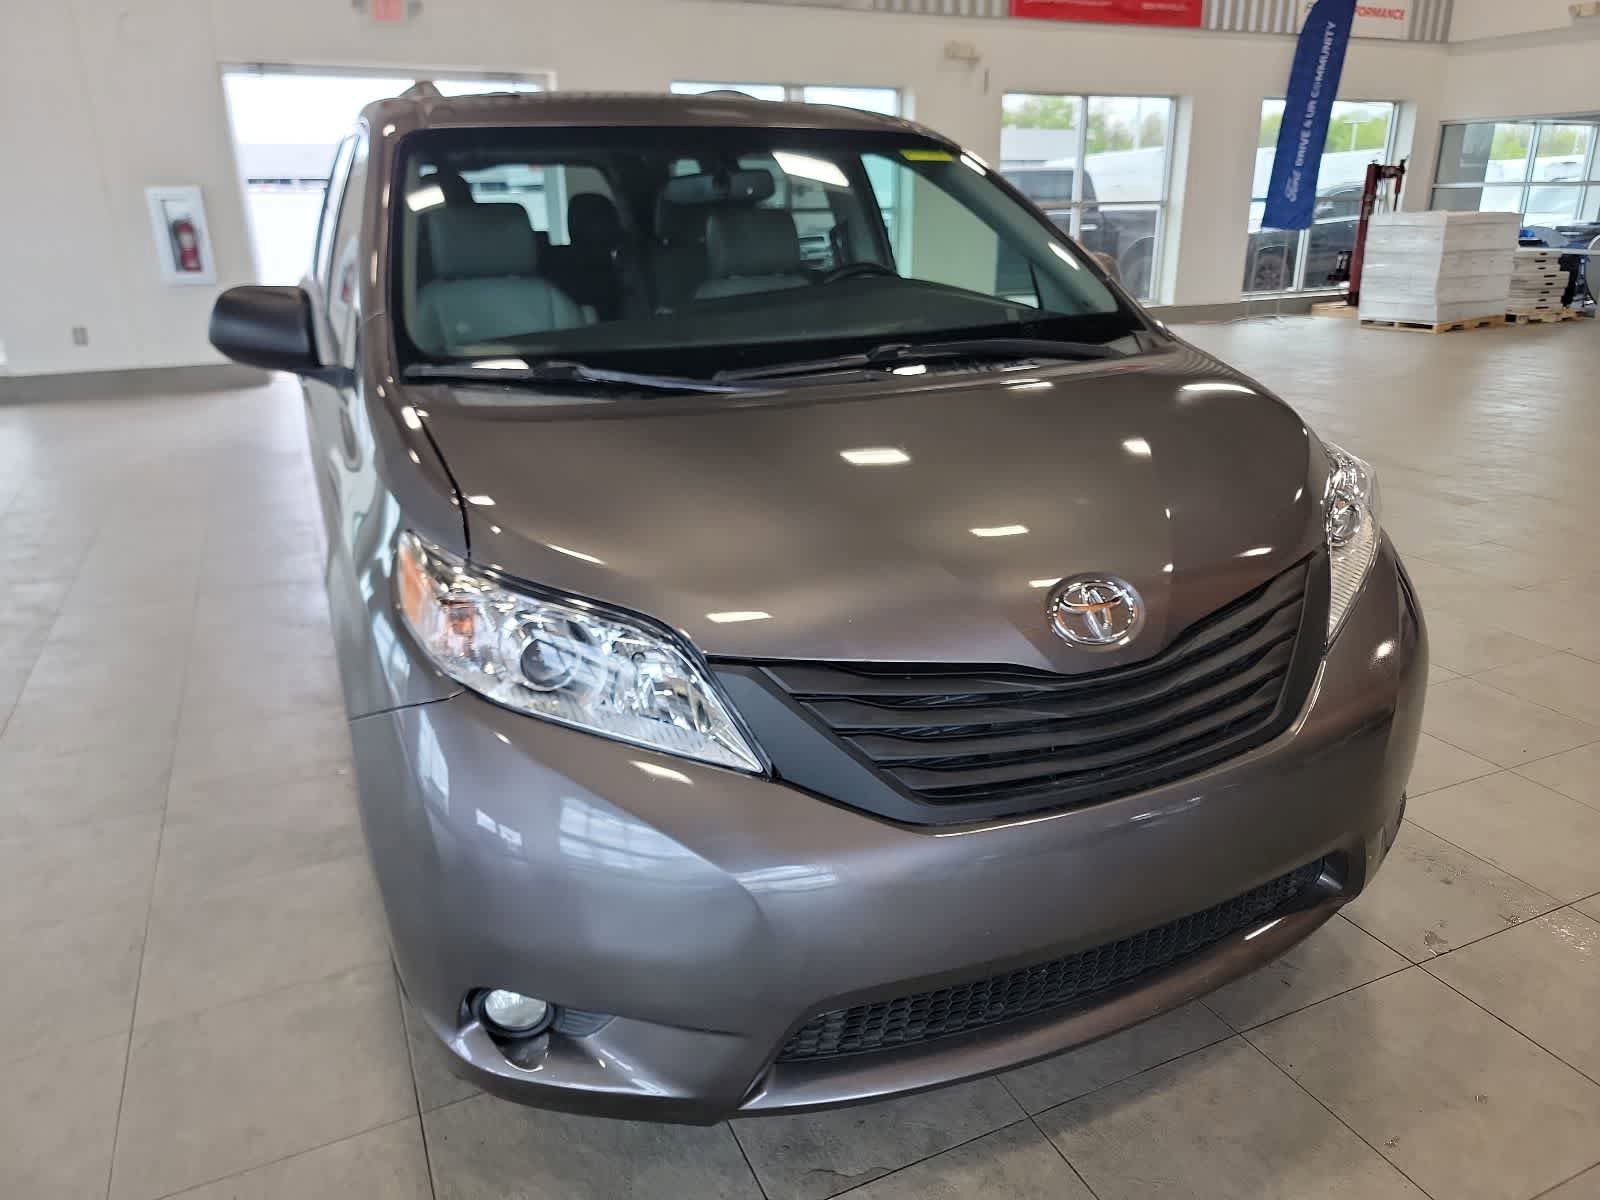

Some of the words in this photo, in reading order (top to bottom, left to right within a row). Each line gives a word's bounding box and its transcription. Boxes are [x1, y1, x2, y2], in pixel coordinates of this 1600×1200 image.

[1284, 169, 1302, 202] Ford
[1295, 130, 1311, 167] DRIVE
[1310, 20, 1336, 98] COMMUNITY
